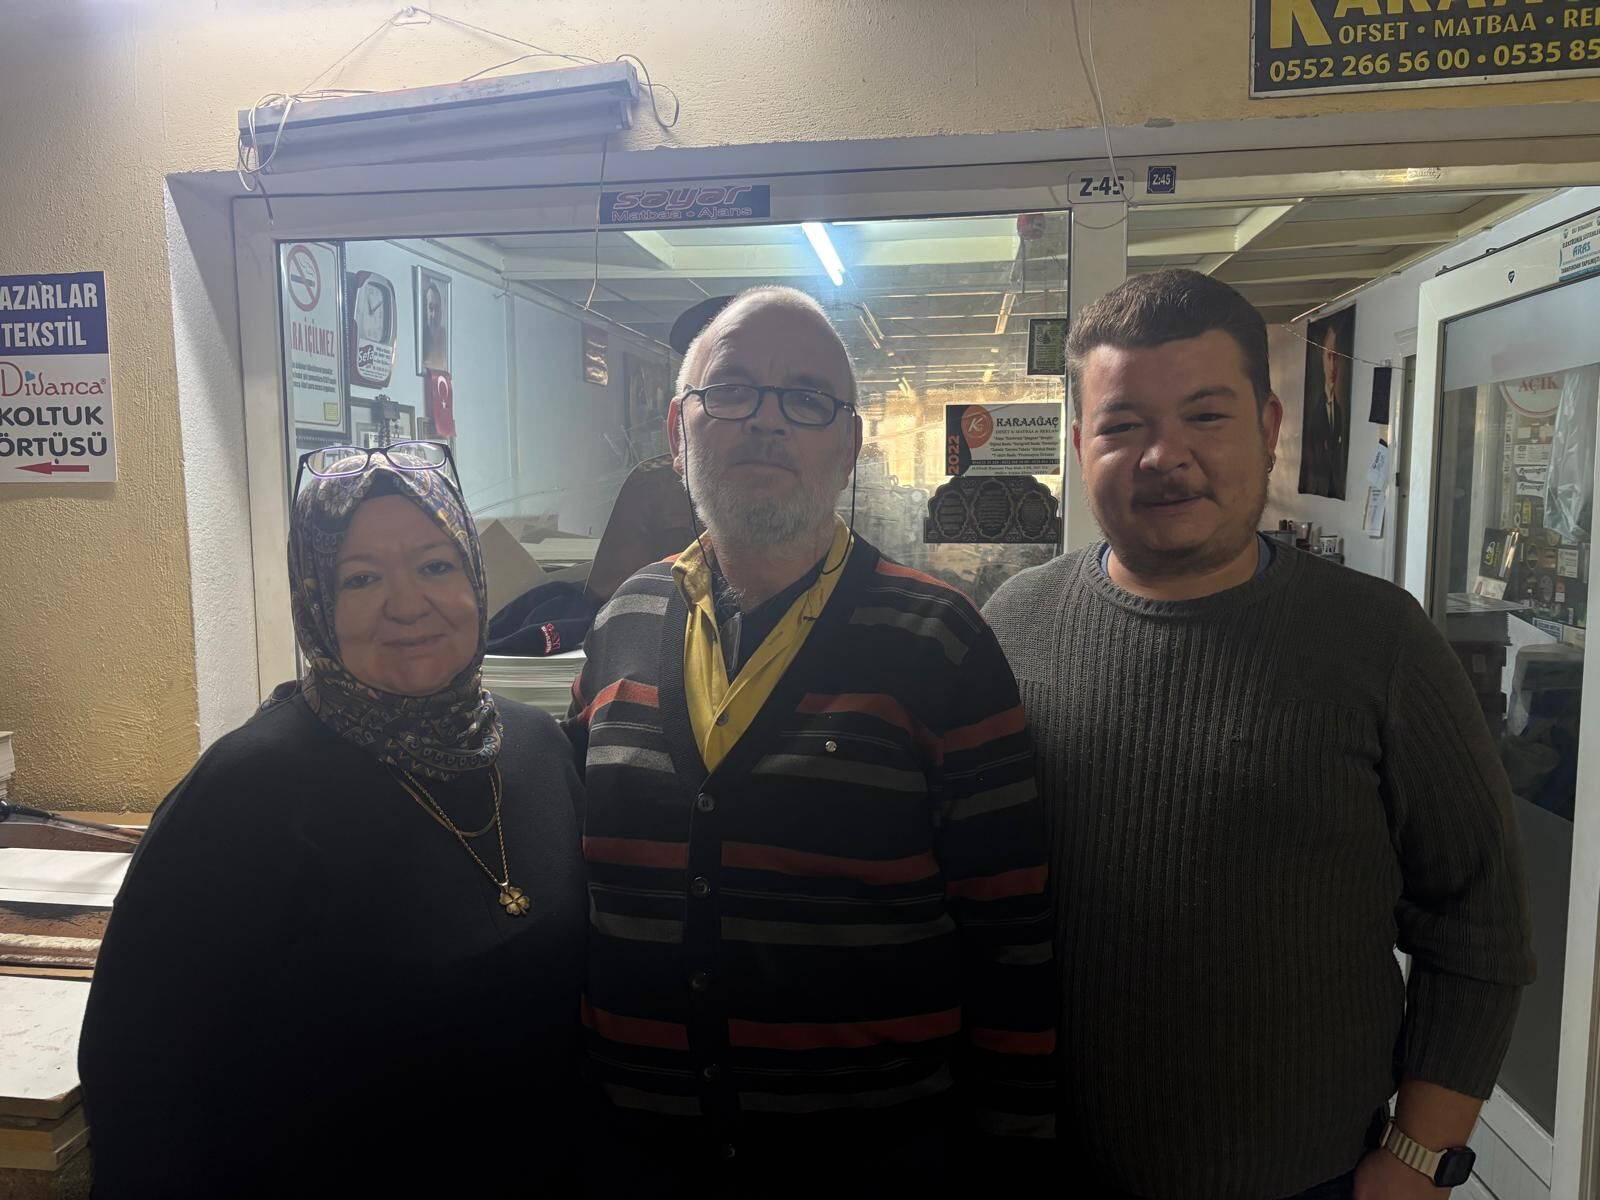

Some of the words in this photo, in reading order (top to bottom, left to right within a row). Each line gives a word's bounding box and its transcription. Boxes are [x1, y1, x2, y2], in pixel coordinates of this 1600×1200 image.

[1338, 22, 1409, 45] OFSET
[1433, 12, 1537, 38] MATBAA
[1563, 7, 1600, 29] RE
[1268, 56, 1335, 82] 0552
[1341, 52, 1391, 78] 266
[1397, 50, 1431, 73] 56
[1437, 48, 1470, 70] 00
[1492, 41, 1562, 66] 0535
[613, 185, 752, 211] sayar
[1079, 176, 1125, 197] Z-45
[611, 209, 682, 222] Matbaa
[698, 206, 752, 219] Ajans
[1572, 241, 1592, 257] ARAS
[1, 315, 87, 347] TEKSTİL
[304, 316, 336, 358] İÇİLMEZ
[0, 406, 104, 426] KOLTUK
[0, 431, 108, 457] ÖRTÜSÜ
[948, 435, 960, 475] 2022
